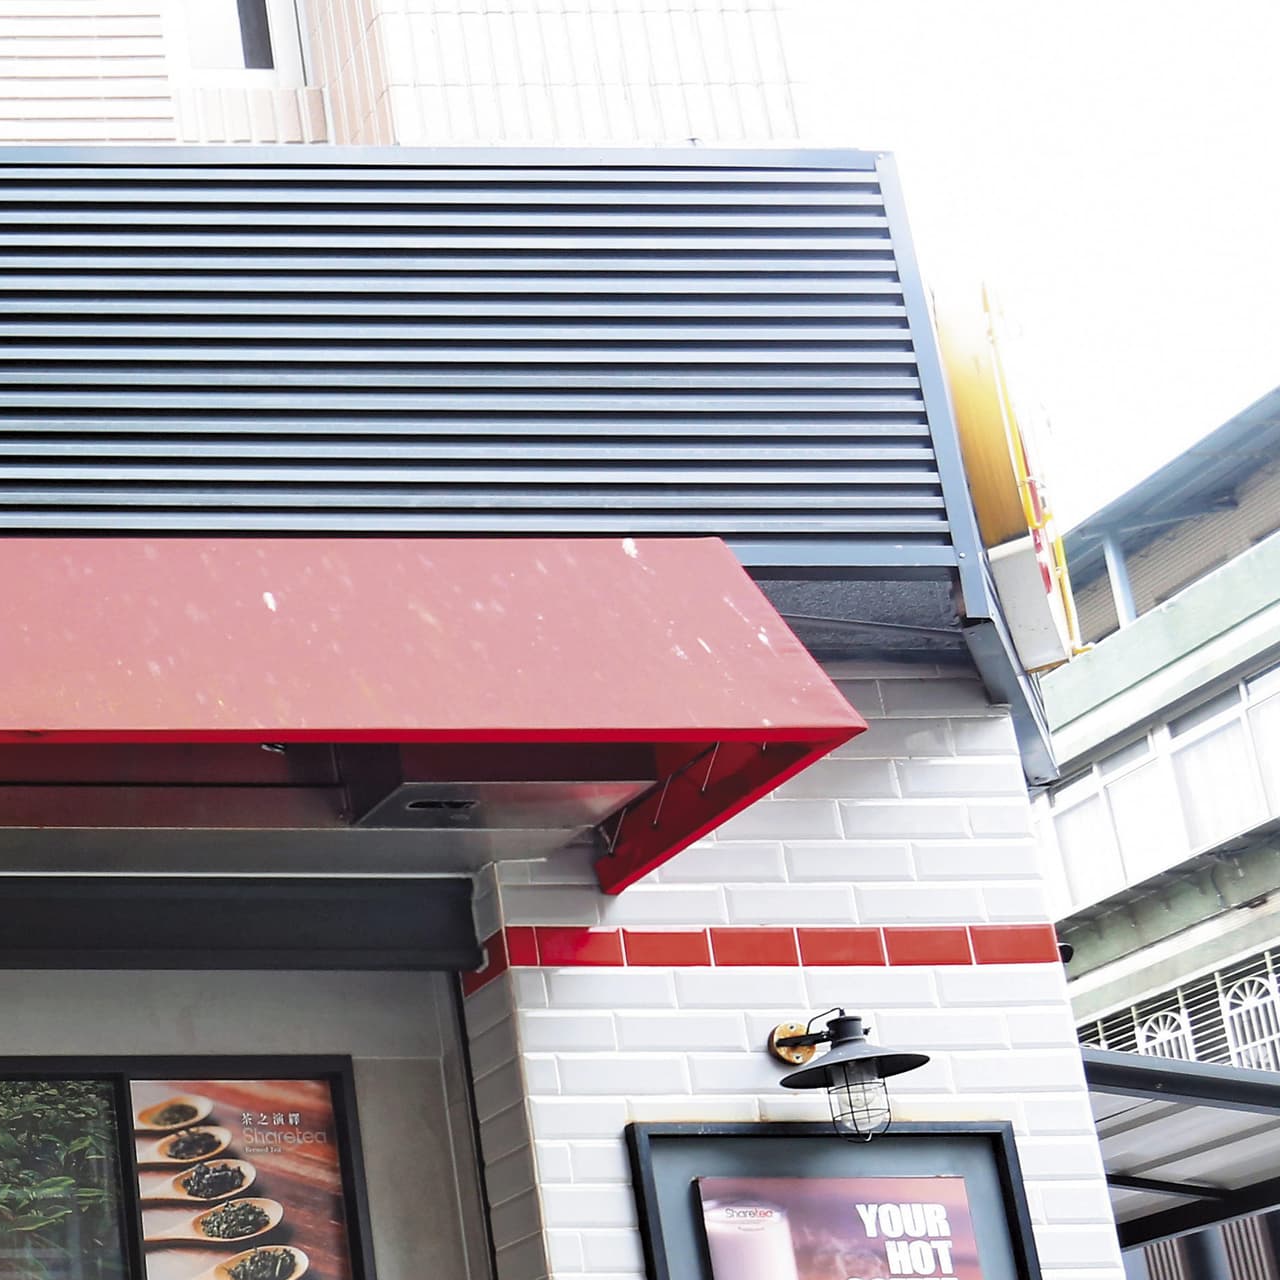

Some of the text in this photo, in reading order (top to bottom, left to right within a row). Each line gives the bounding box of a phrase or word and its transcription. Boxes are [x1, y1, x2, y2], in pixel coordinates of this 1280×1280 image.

[242, 1127, 327, 1144] Sharetea
[854, 1203, 951, 1238] YOUR
[885, 1240, 954, 1275] HOT
